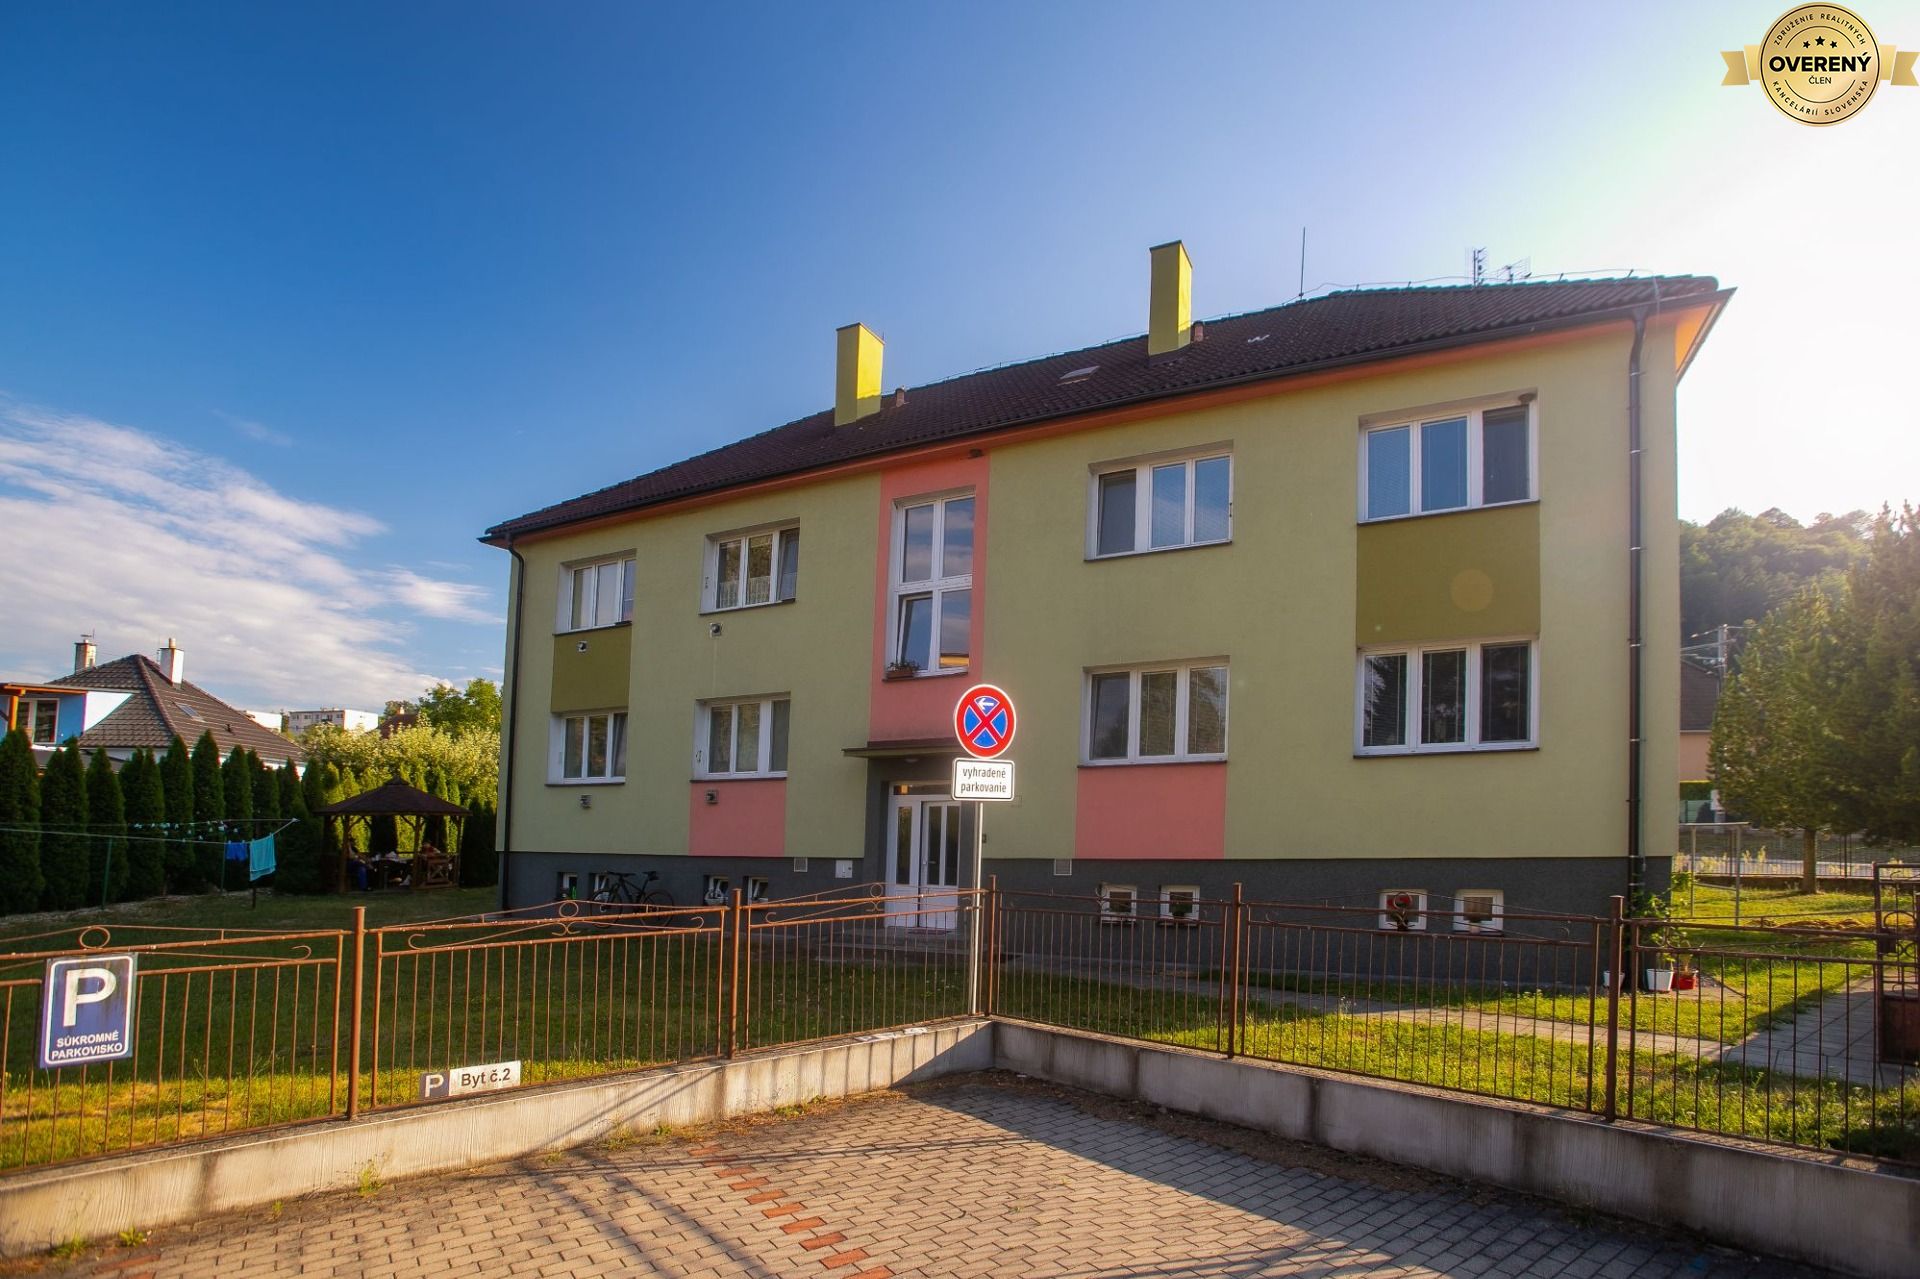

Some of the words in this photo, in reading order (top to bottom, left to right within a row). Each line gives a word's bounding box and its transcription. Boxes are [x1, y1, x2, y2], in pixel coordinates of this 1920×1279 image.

[962, 766, 1007, 779] vyhradené
[960, 782, 1007, 794] parkovanie
[63, 968, 117, 1027] P
[56, 1029, 119, 1048] SÚKROMNÉ
[51, 1042, 123, 1060] PARKOVISKO
[425, 1074, 444, 1098] P
[461, 1071, 486, 1089] Byt
[490, 1068, 511, 1083] č.2
